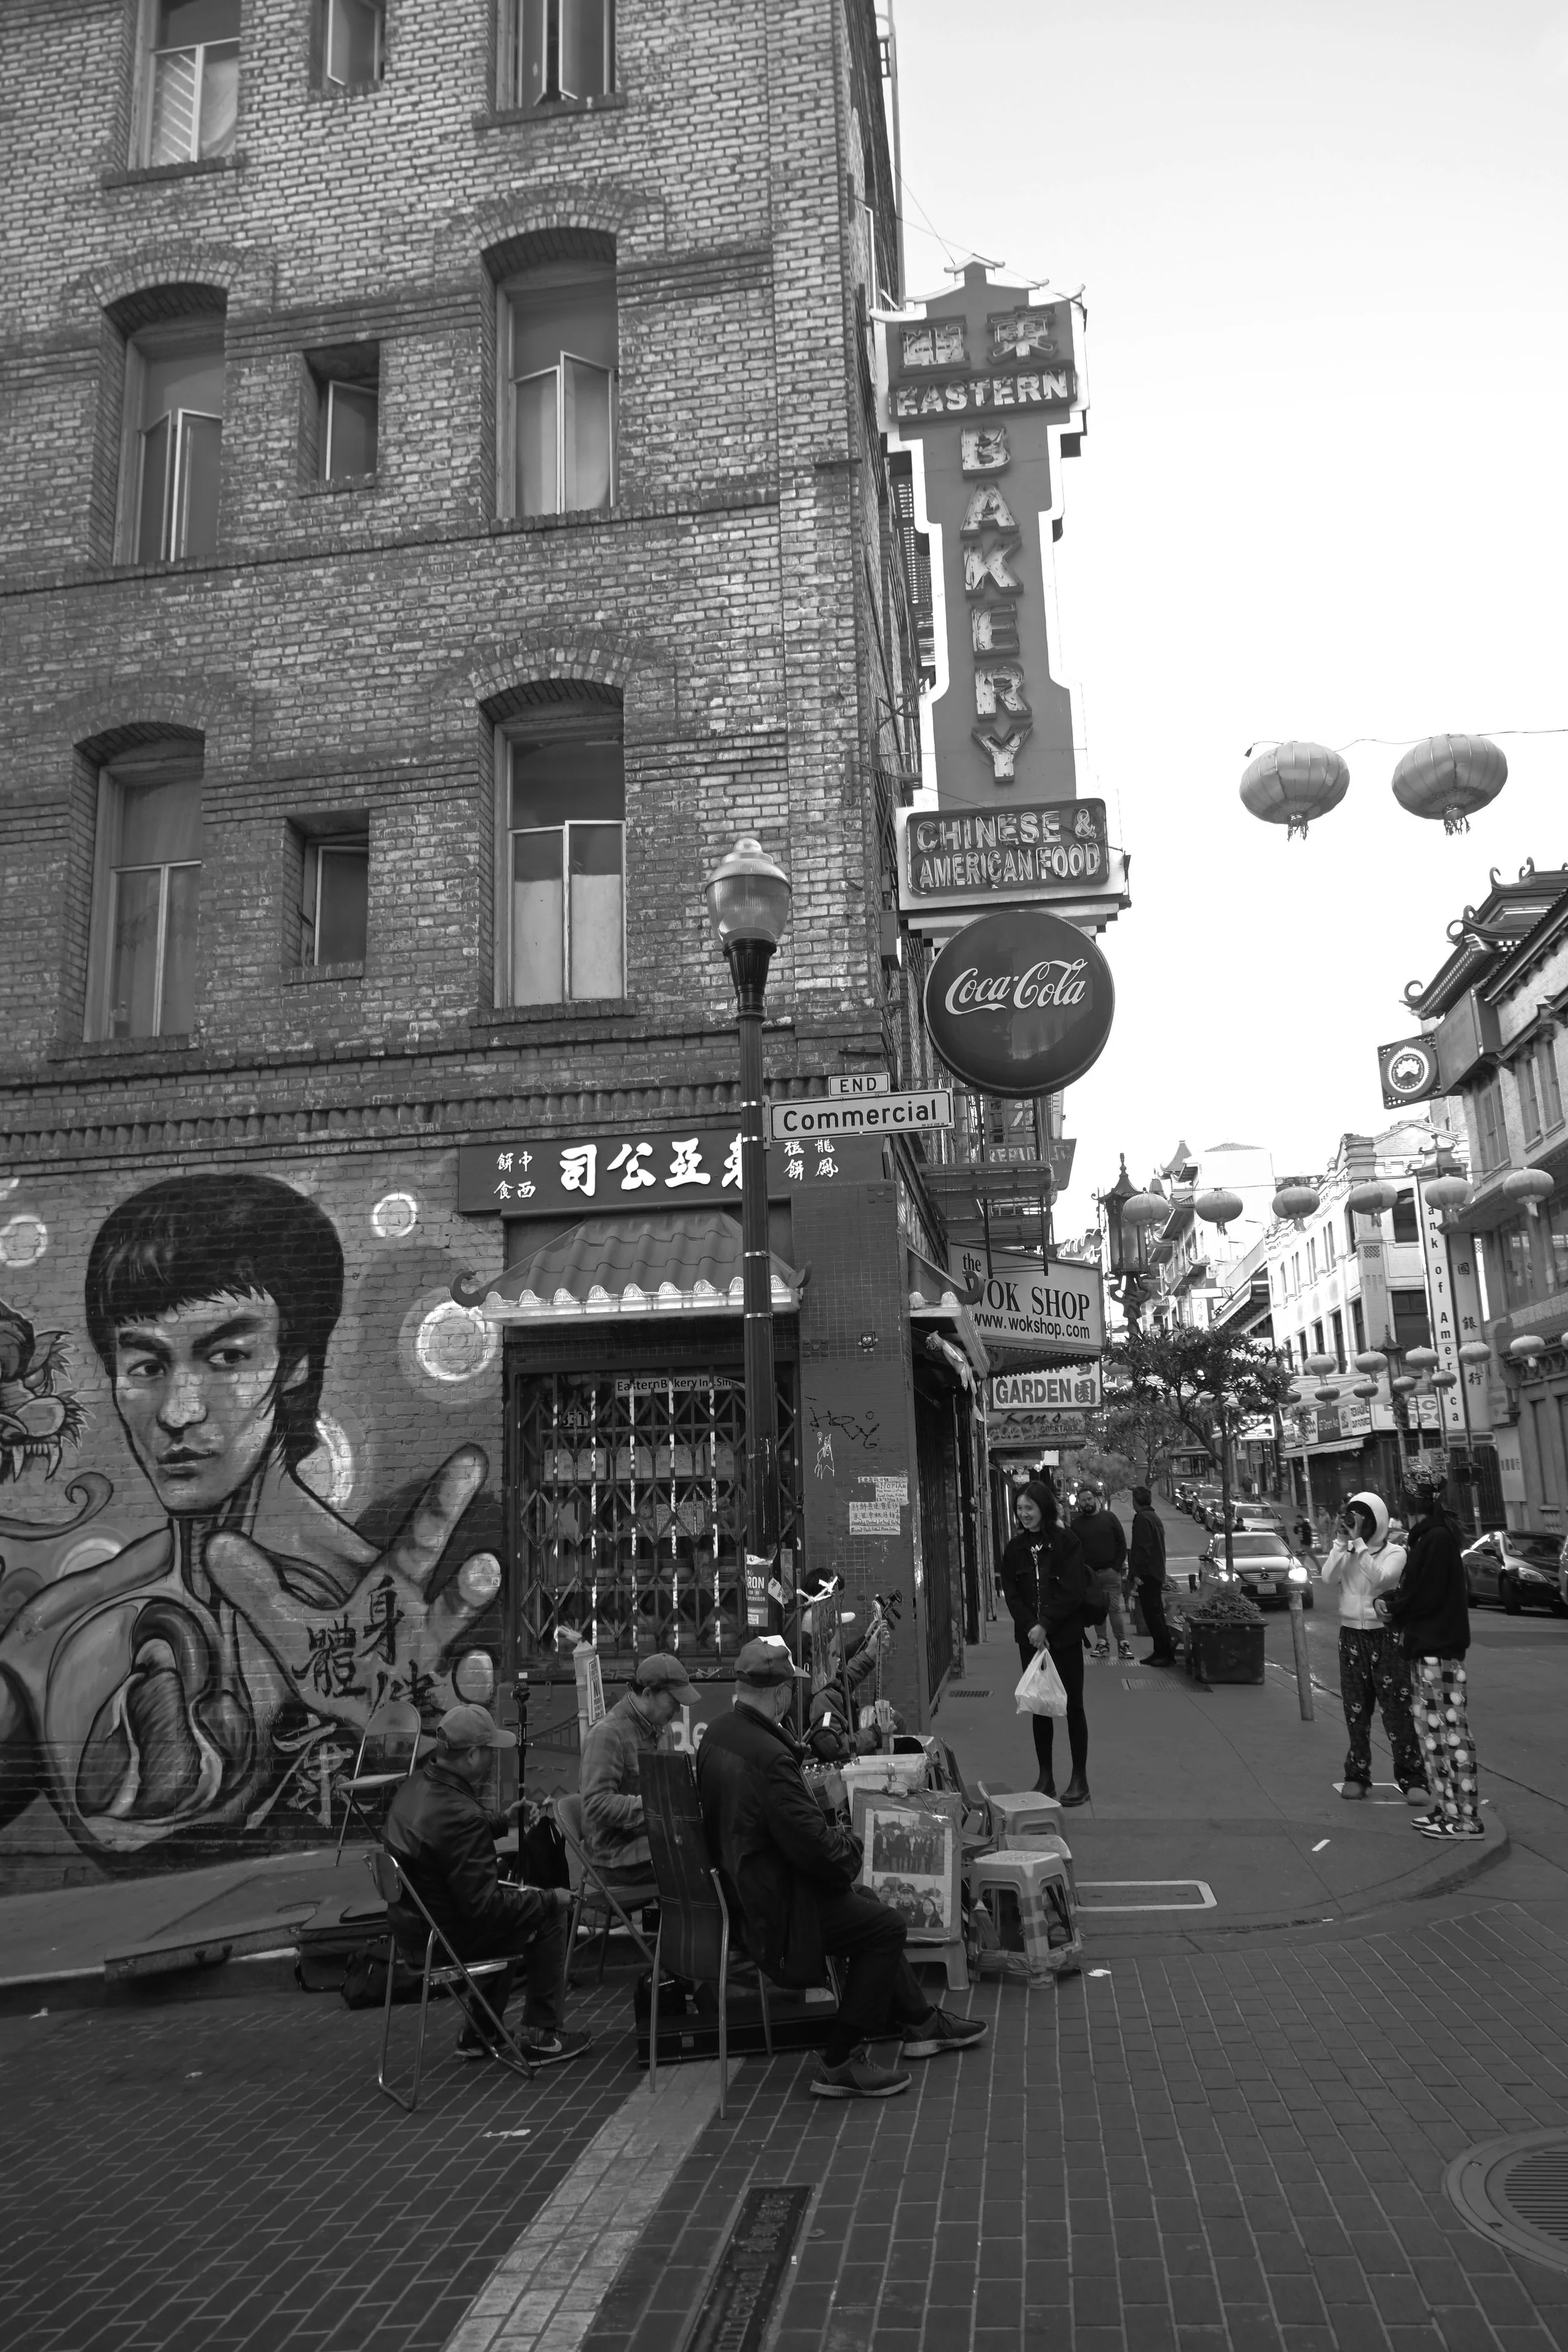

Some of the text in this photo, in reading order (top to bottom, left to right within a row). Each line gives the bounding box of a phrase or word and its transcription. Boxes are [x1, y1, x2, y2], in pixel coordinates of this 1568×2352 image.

[897, 369, 1068, 416] EASTERN
[960, 425, 1033, 782] BAKERY
[916, 808, 1098, 853] CHINESE &
[919, 842, 1101, 887] AMERICAN FOOD
[945, 958, 1088, 1015] Coca-Cola
[840, 1077, 877, 1093] END
[783, 1099, 936, 1131] Commercial
[962, 1253, 982, 1273] the
[1031, 1286, 1090, 1322] SHOP
[974, 1312, 1090, 1340] www.wokshop.com
[1440, 1311, 1459, 1422] Amerca
[995, 1378, 1072, 1404] GARDEN
[747, 1576, 765, 1589] RON
